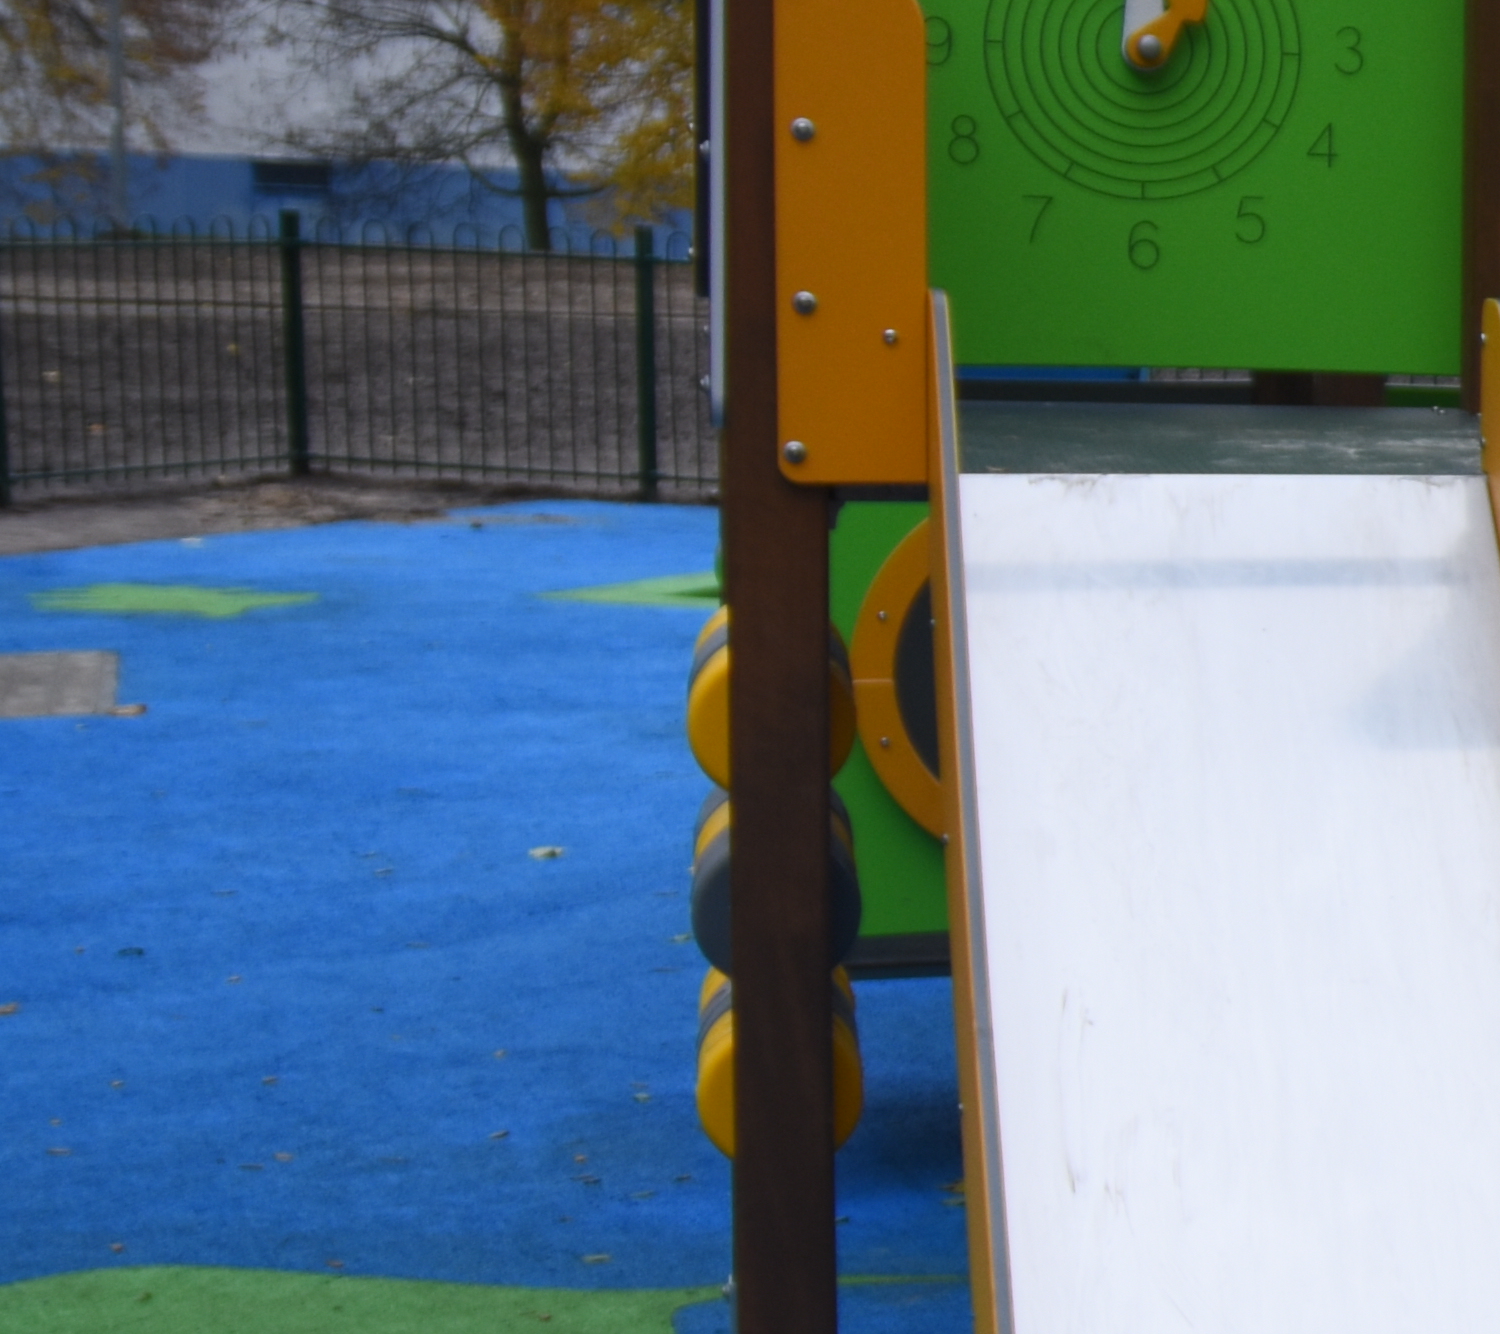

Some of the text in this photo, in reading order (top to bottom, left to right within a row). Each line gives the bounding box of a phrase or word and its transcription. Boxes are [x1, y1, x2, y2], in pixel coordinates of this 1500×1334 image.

[925, 15, 953, 66] 9
[1334, 26, 1364, 75] 3
[947, 115, 980, 166] 8
[1306, 122, 1338, 168] 4
[1021, 194, 1054, 244] 7
[1234, 195, 1266, 245] 5
[1126, 220, 1161, 270] 6
